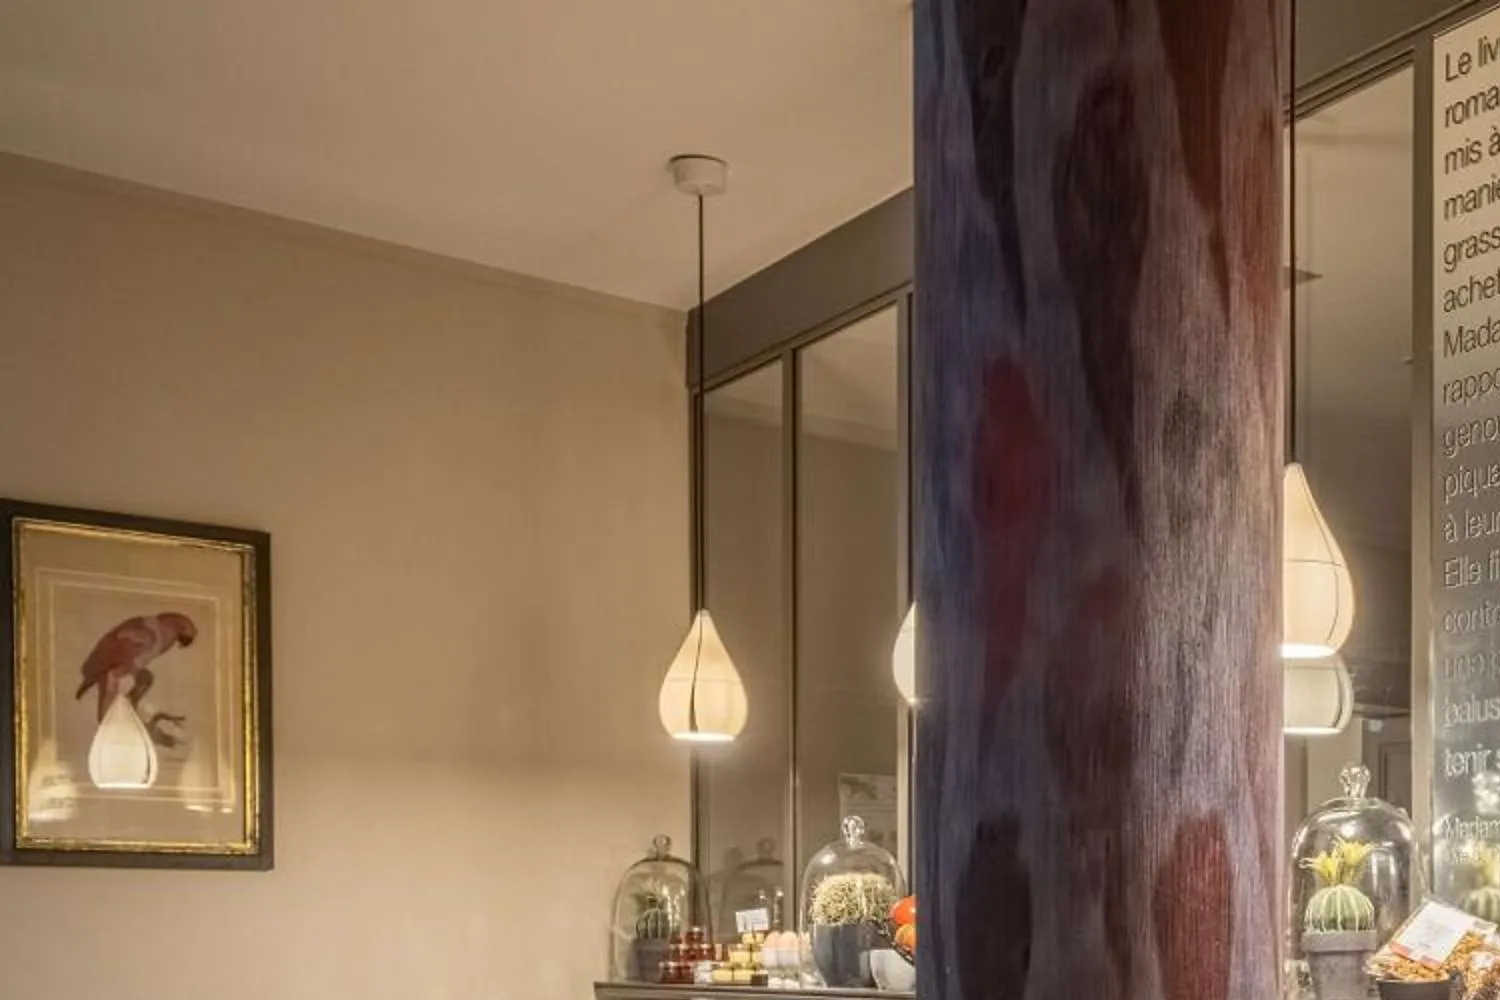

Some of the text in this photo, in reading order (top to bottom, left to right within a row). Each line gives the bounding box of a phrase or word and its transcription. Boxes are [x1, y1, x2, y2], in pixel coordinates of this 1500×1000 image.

[1445, 52, 1472, 82] Le
[1445, 137, 1482, 175] mis
[1443, 514, 1458, 543] à
[1443, 557, 1482, 589] Elle
[1444, 744, 1492, 776] tenir
